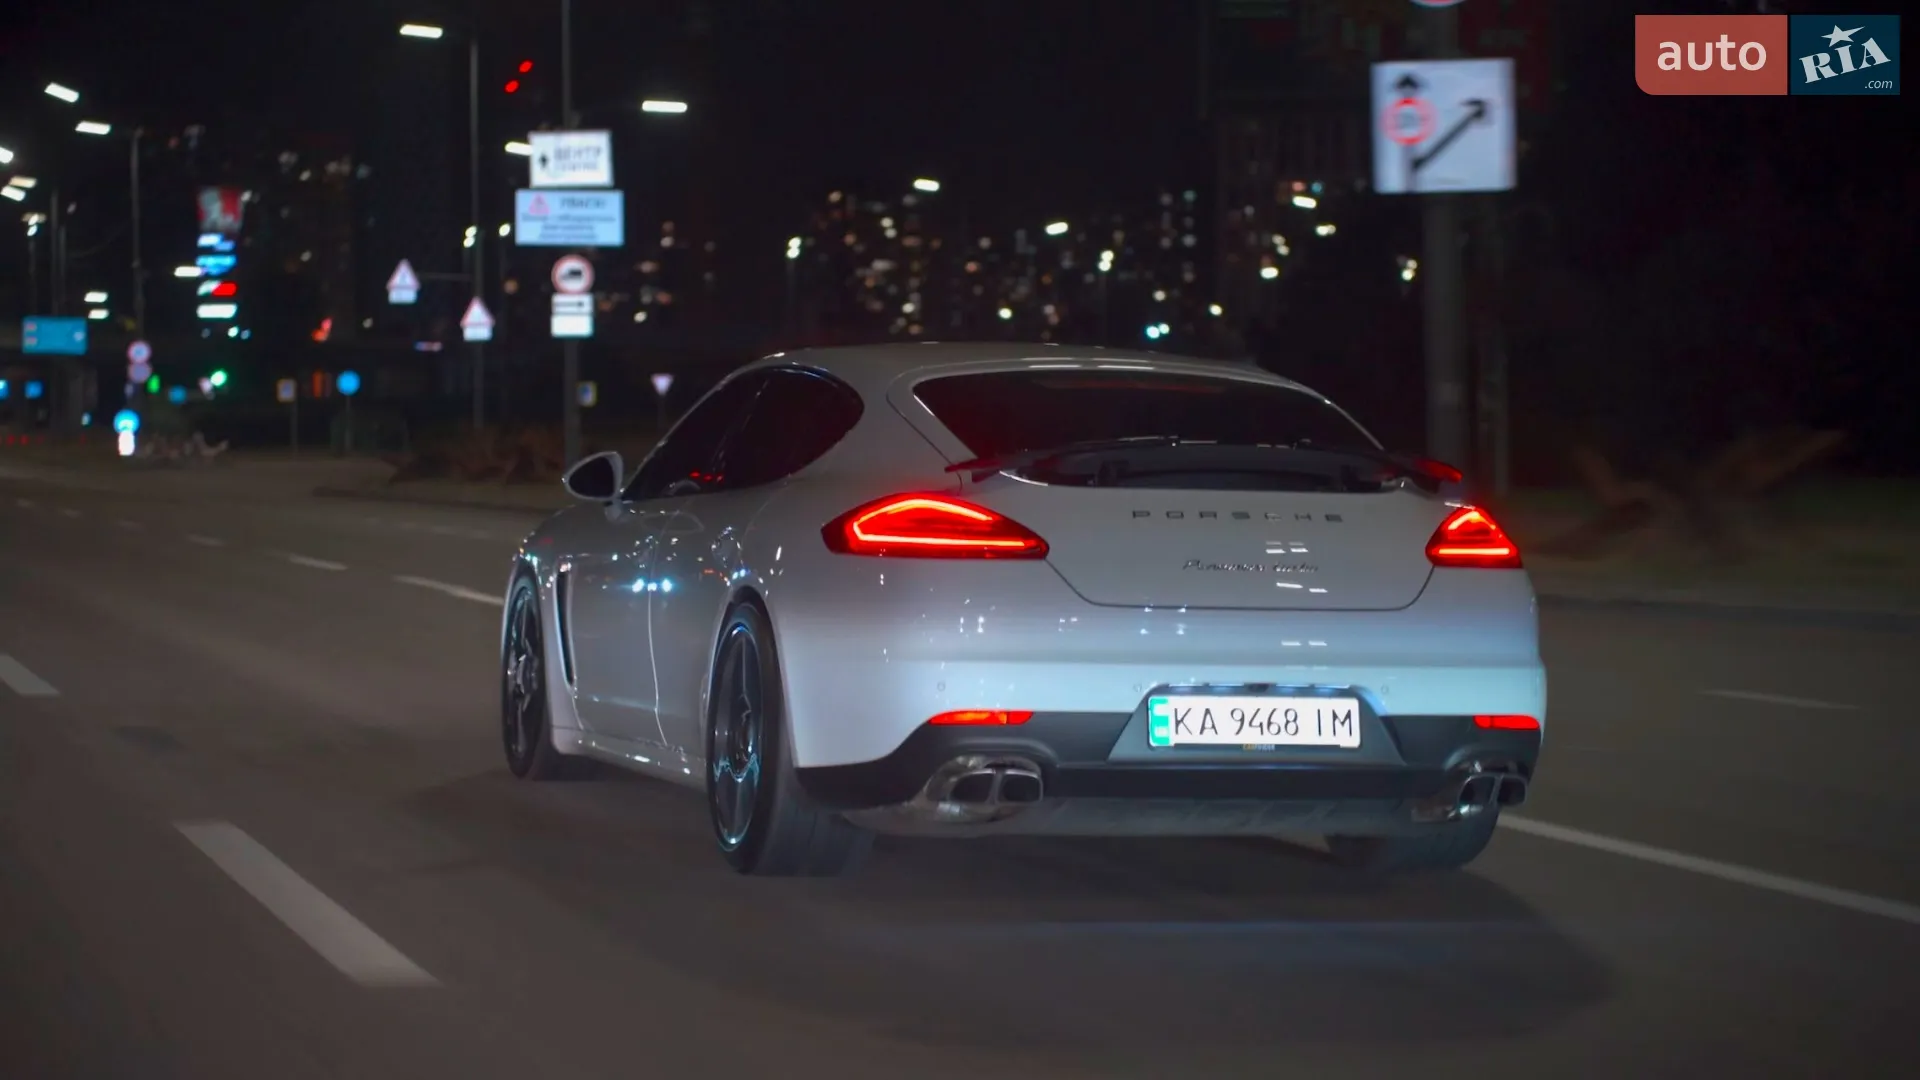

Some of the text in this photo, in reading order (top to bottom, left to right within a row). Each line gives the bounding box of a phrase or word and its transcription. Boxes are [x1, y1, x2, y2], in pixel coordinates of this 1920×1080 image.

[1132, 510, 1344, 522] PORSCHE
[1174, 707, 1353, 737] KA 9468 IM
